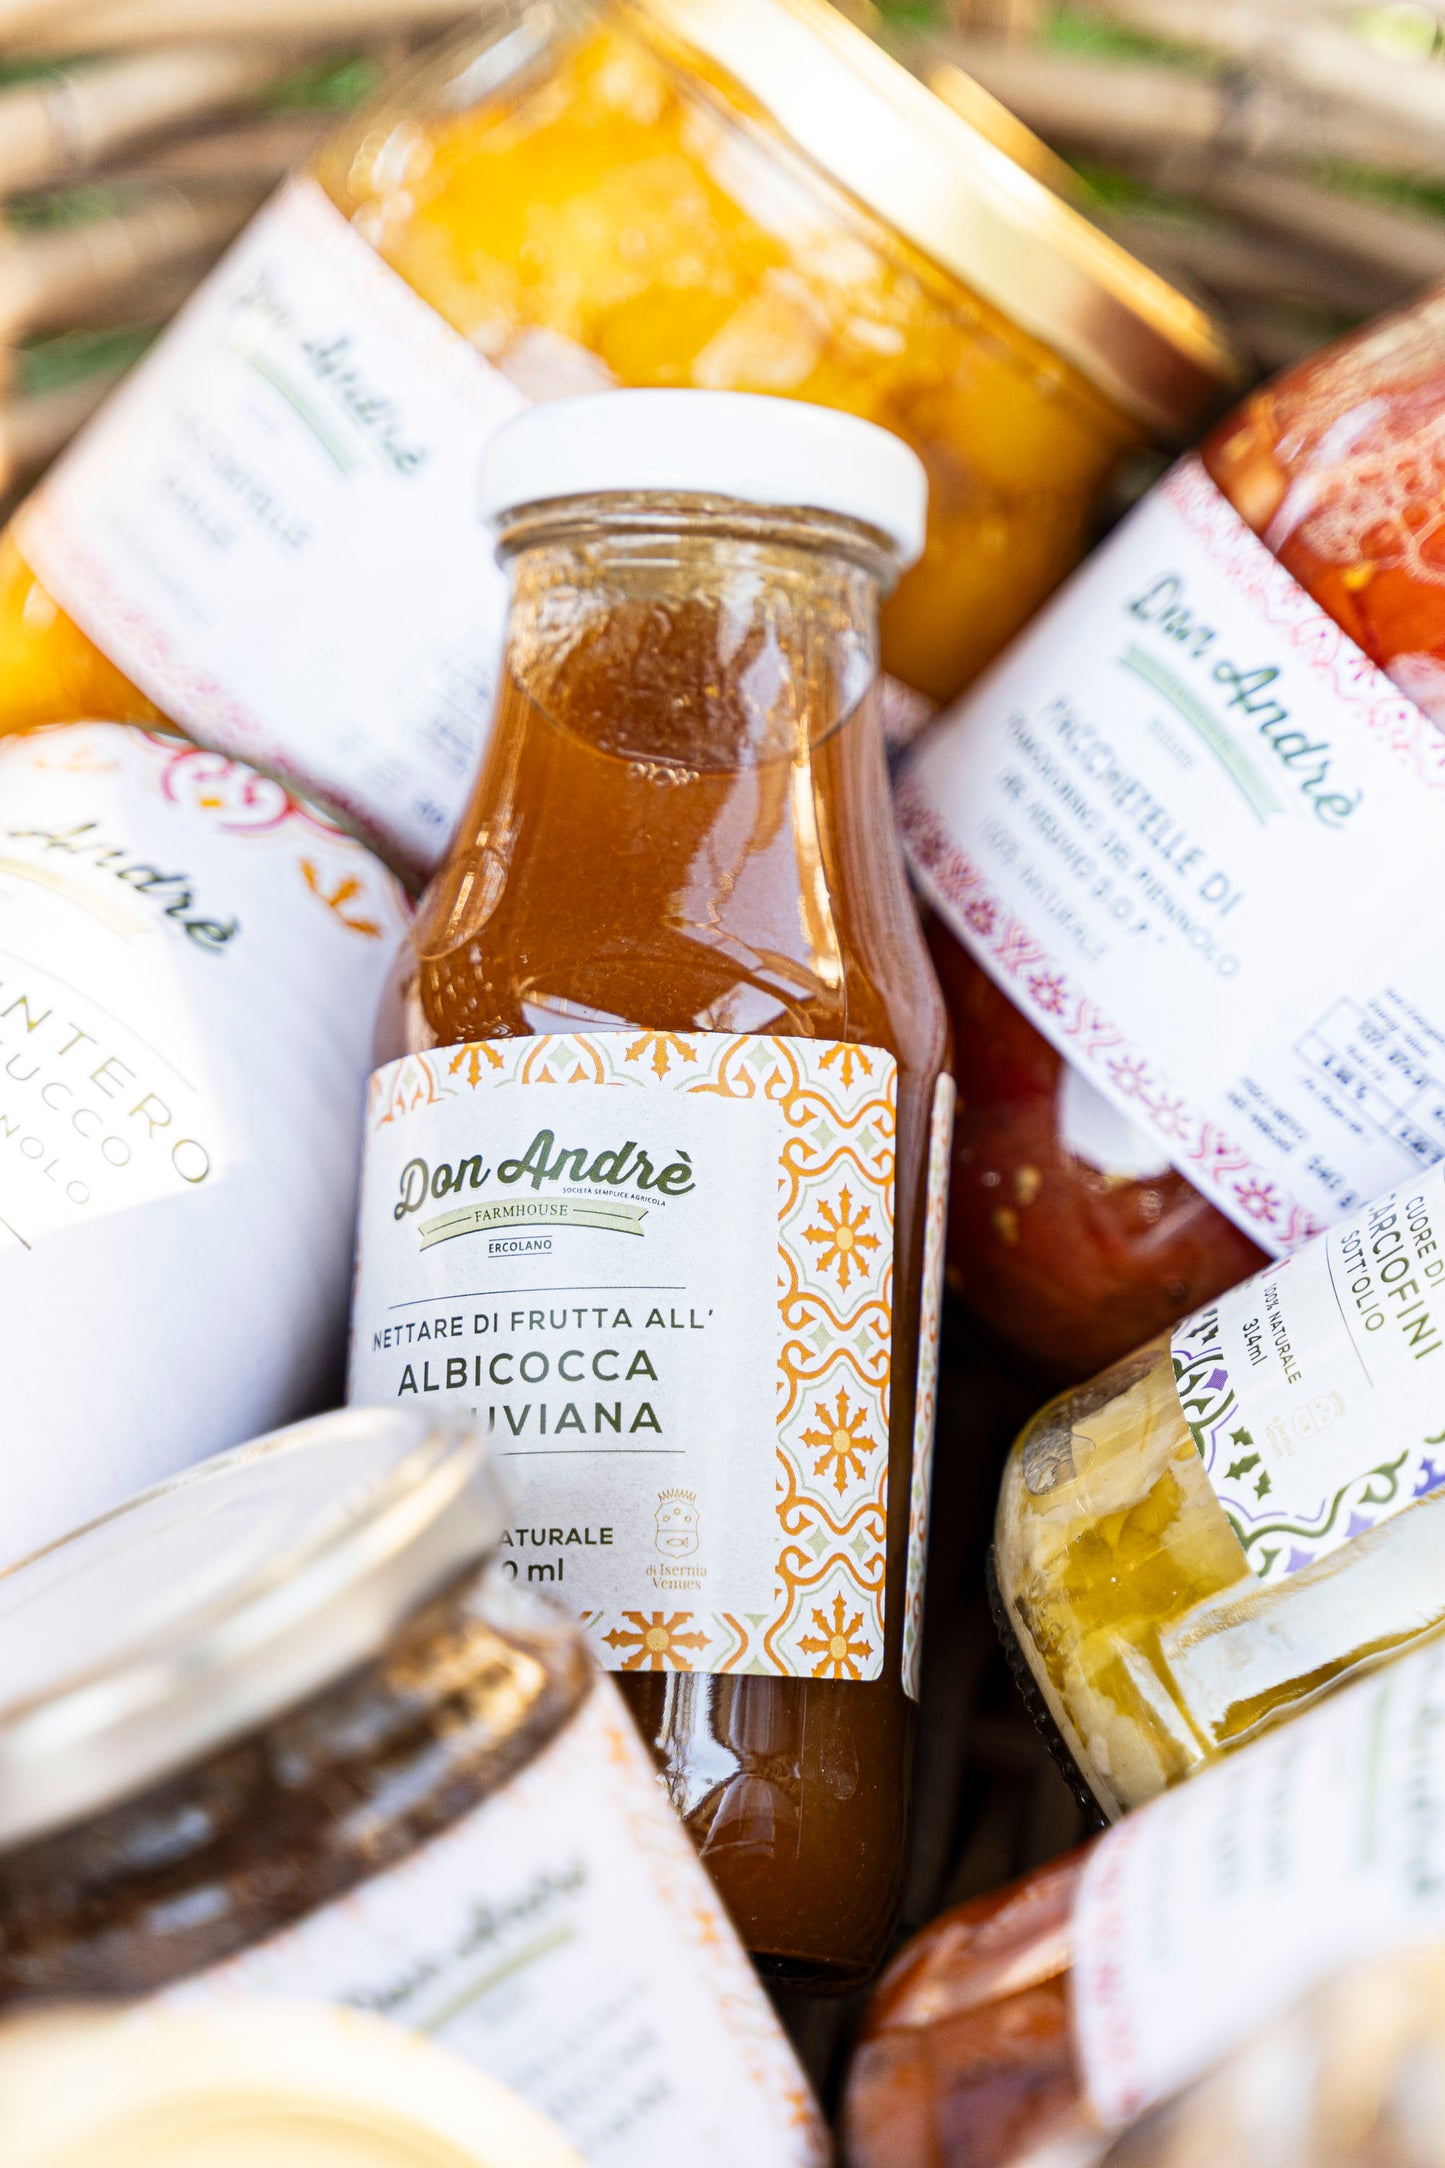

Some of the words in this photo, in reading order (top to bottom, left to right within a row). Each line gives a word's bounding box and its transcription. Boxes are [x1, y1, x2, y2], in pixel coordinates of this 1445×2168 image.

[1212, 667, 1364, 829] Andrè
[1198, 871, 1244, 916] DI
[0, 994, 211, 1184] NTERO
[5, 1053, 132, 1168] UCCO
[394, 1157, 491, 1221] Don
[497, 1129, 696, 1196] Andrè
[562, 1186, 592, 1194] SOCIETÀ
[594, 1188, 629, 1199] SEMPLICE
[630, 1194, 666, 1207] AGRICOLA
[474, 1204, 569, 1223] FARMHOUSE
[488, 1239, 552, 1254] ERCOLANO
[1405, 1196, 1438, 1260] CUORE
[1424, 1258, 1445, 1288] DI
[1340, 1229, 1385, 1332] SOTT'OLIO
[1368, 1193, 1443, 1360] ARCIOFINI
[373, 1316, 464, 1352] NETTARE
[474, 1312, 498, 1335] DI
[510, 1308, 634, 1332] FRUTTA
[644, 1307, 714, 1330] ALL'
[1242, 1317, 1269, 1366] 314ml
[1268, 1310, 1302, 1384] NATURALE
[396, 1349, 659, 1397] ALBICOCCA
[471, 1402, 663, 1436] UVIANA
[501, 1527, 614, 1548] ATURALE
[527, 1557, 564, 1582] ml
[652, 1577, 701, 1590] Venues
[659, 1564, 707, 1577] Isernia
